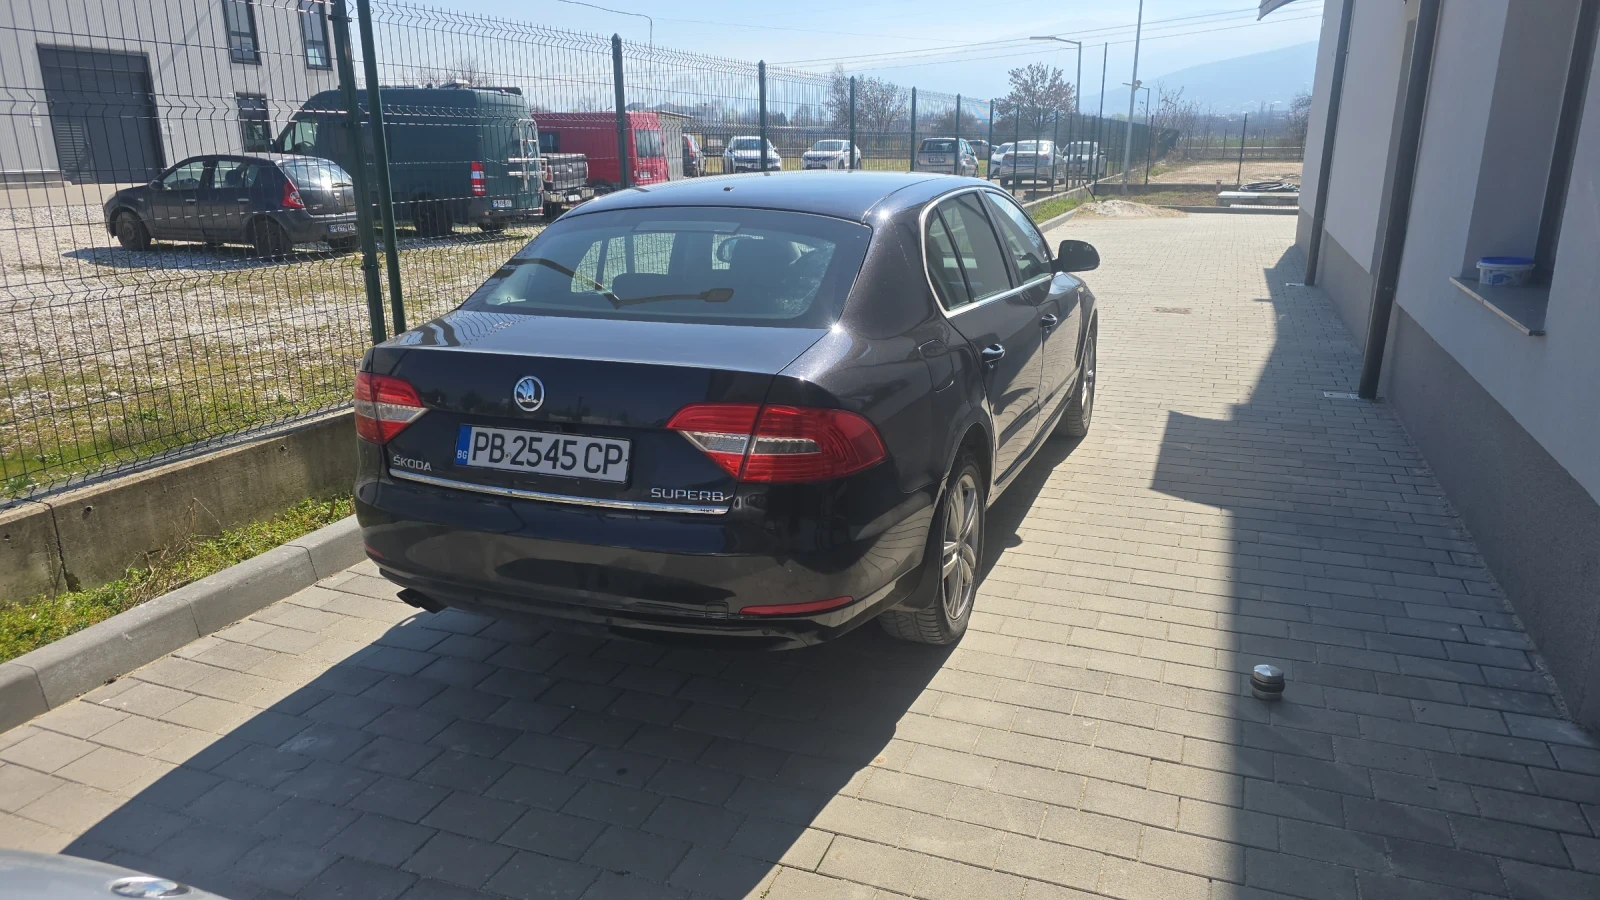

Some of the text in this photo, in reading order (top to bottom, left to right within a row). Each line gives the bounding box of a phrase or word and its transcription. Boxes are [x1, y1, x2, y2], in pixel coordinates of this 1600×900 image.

[457, 450, 468, 459] BG
[472, 431, 623, 475] PB 2545 CP
[393, 454, 432, 471] ŠKODA
[651, 487, 724, 502] SUPERB
